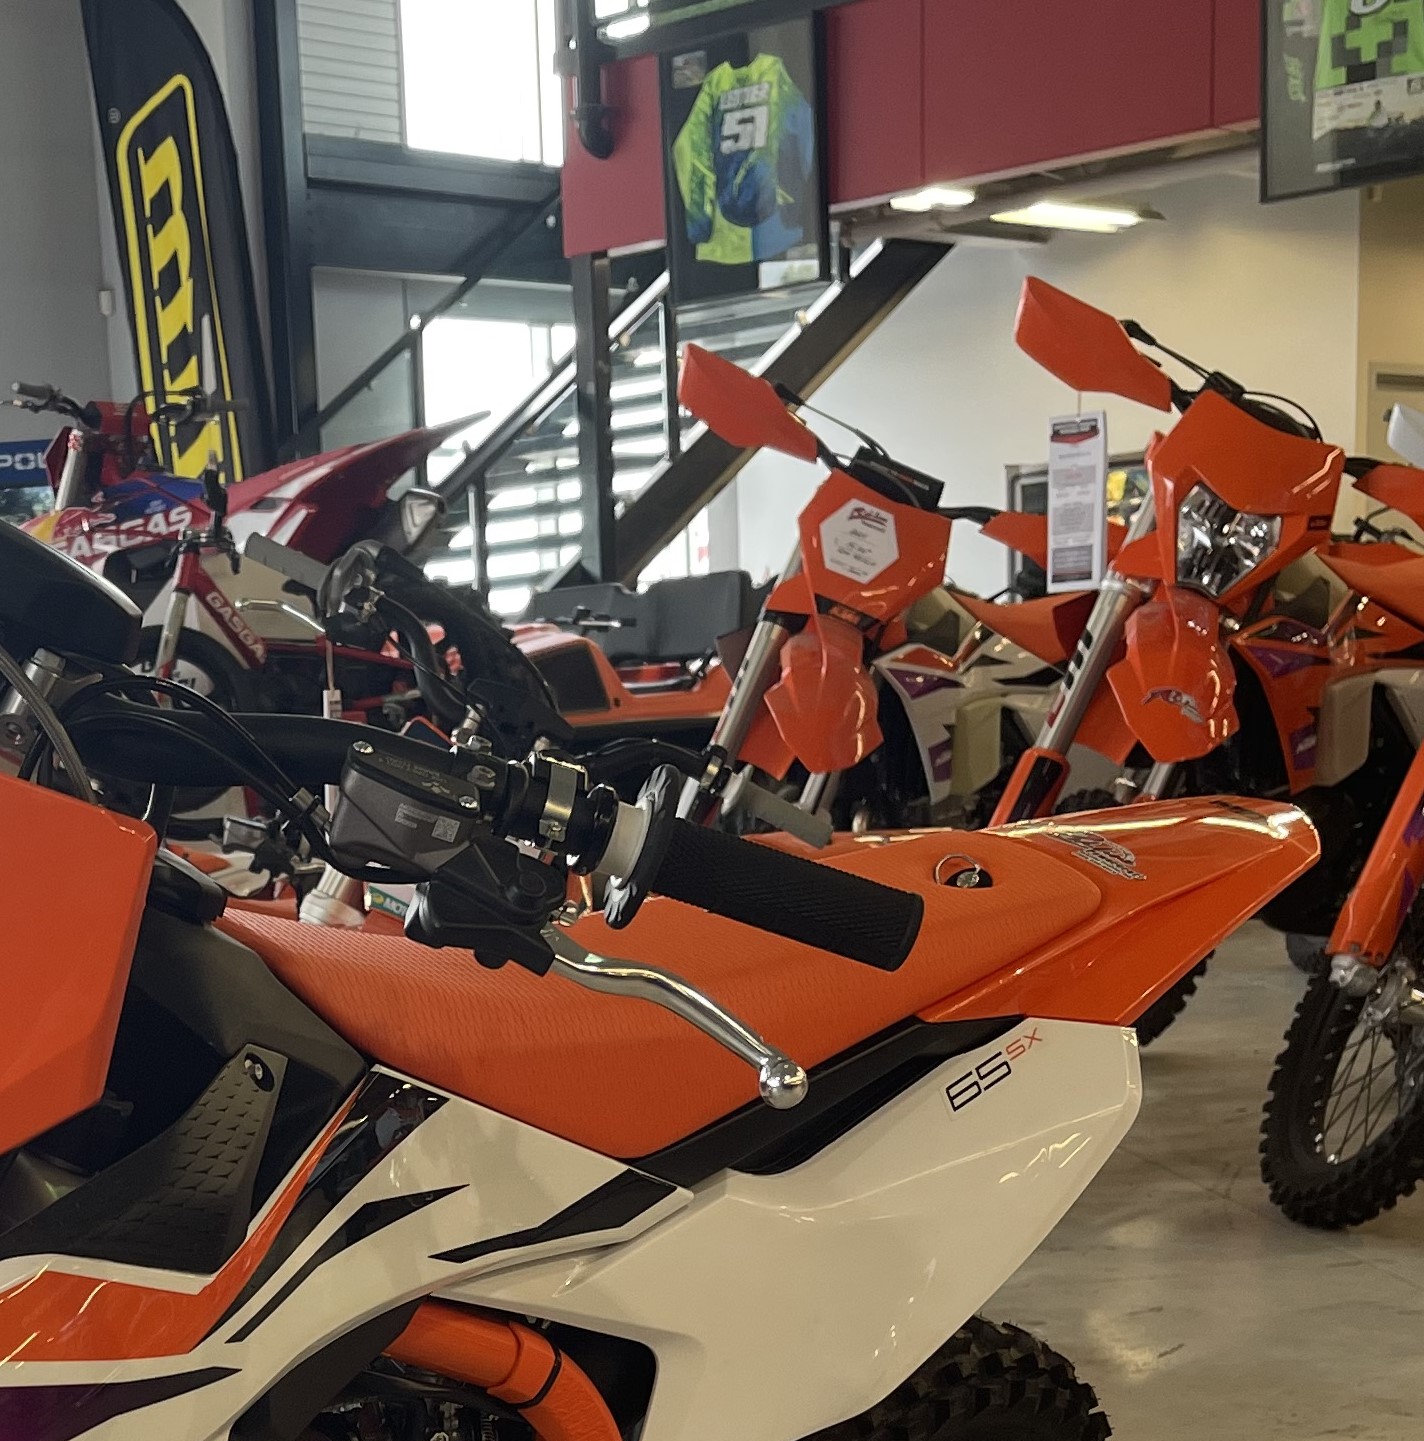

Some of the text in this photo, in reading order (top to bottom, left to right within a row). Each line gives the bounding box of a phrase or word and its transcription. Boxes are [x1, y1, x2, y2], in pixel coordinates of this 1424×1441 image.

[720, 105, 769, 155] 51
[945, 1027, 1043, 1112] 65 SX
